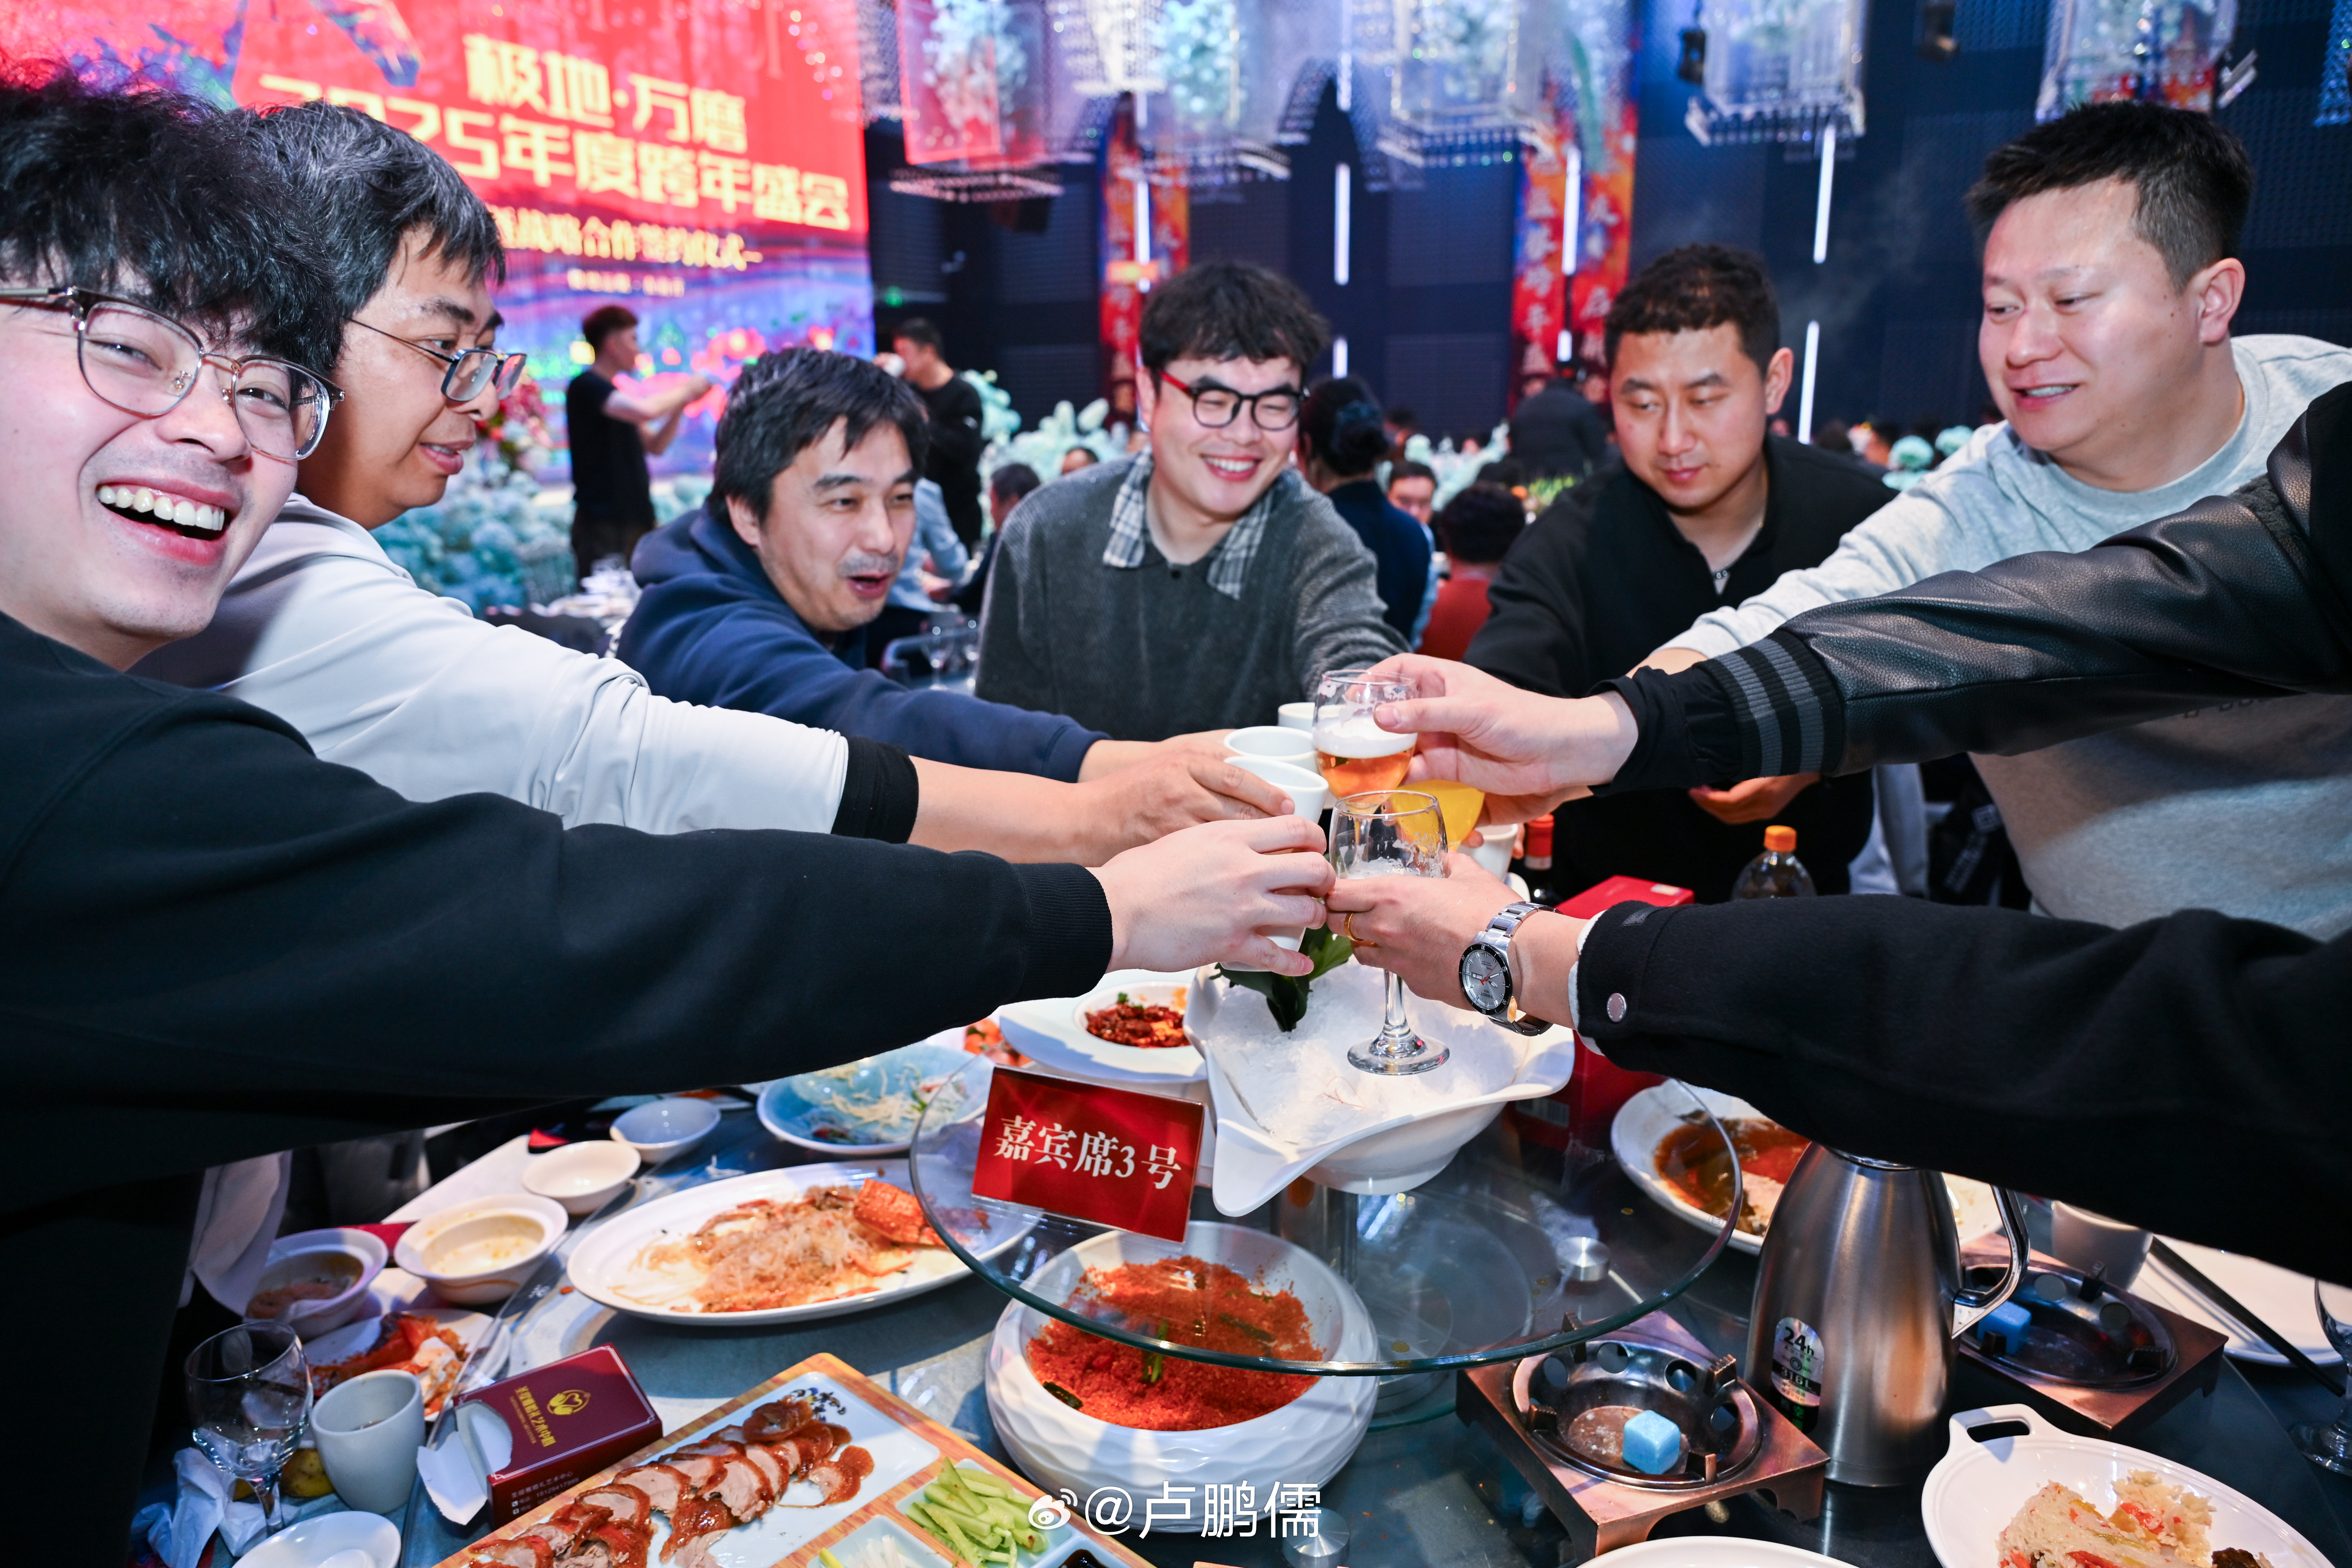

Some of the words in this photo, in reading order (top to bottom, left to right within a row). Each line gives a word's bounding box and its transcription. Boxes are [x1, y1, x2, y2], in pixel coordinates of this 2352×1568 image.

[259, 74, 850, 230] 25年度跨年盛会
[994, 1115, 1181, 1189] 嘉宾席3号
[1784, 1326, 1814, 1356] 24h
[1781, 1367, 1812, 1389] 316L
